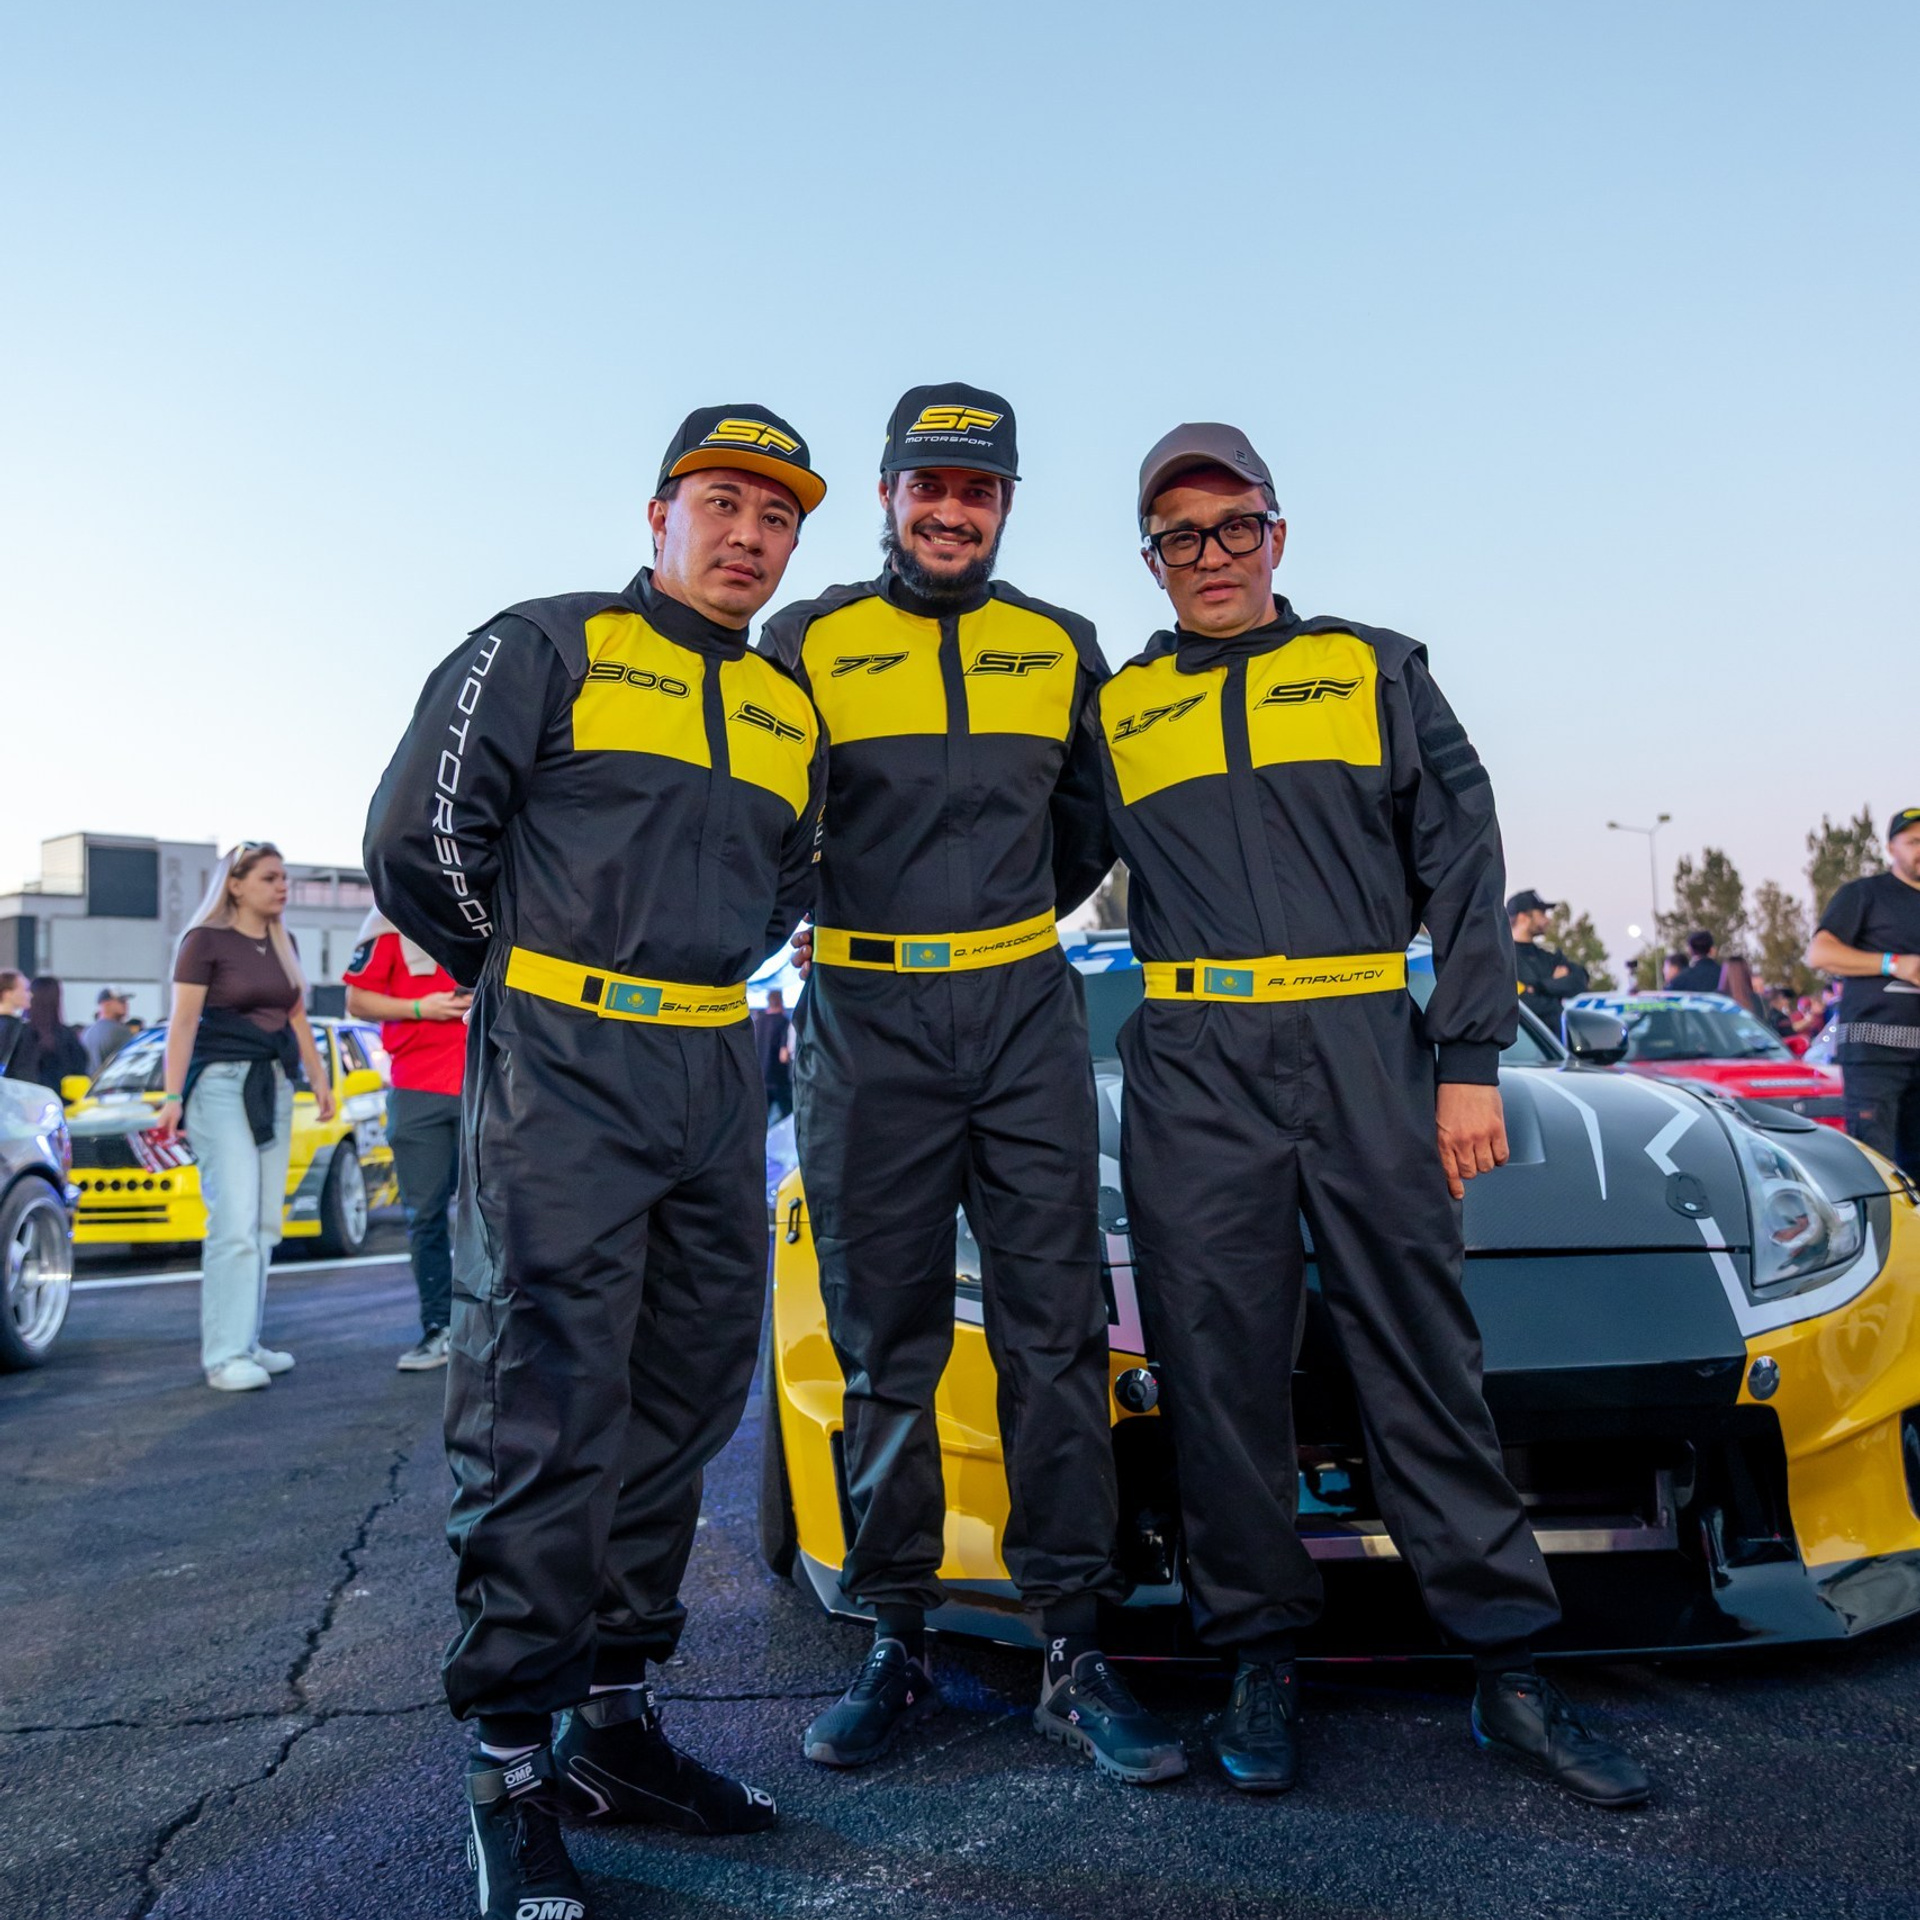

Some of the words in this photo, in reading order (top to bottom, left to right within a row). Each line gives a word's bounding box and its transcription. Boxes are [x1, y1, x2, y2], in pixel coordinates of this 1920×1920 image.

[904, 404, 1004, 435] SF
[700, 418, 801, 455] SF
[905, 435, 994, 448] MOTORSPORT
[832, 651, 909, 677] 77
[964, 650, 1064, 676] SF
[586, 660, 690, 698] 900
[1253, 677, 1364, 710] SF
[729, 700, 806, 744] SF
[1112, 692, 1207, 744] 177
[1268, 977, 1287, 987] A.
[1293, 969, 1384, 986] MAXUTOV
[660, 1002, 692, 1013] SH.
[504, 1764, 533, 1786] OMP
[515, 1901, 585, 1920] OMP
